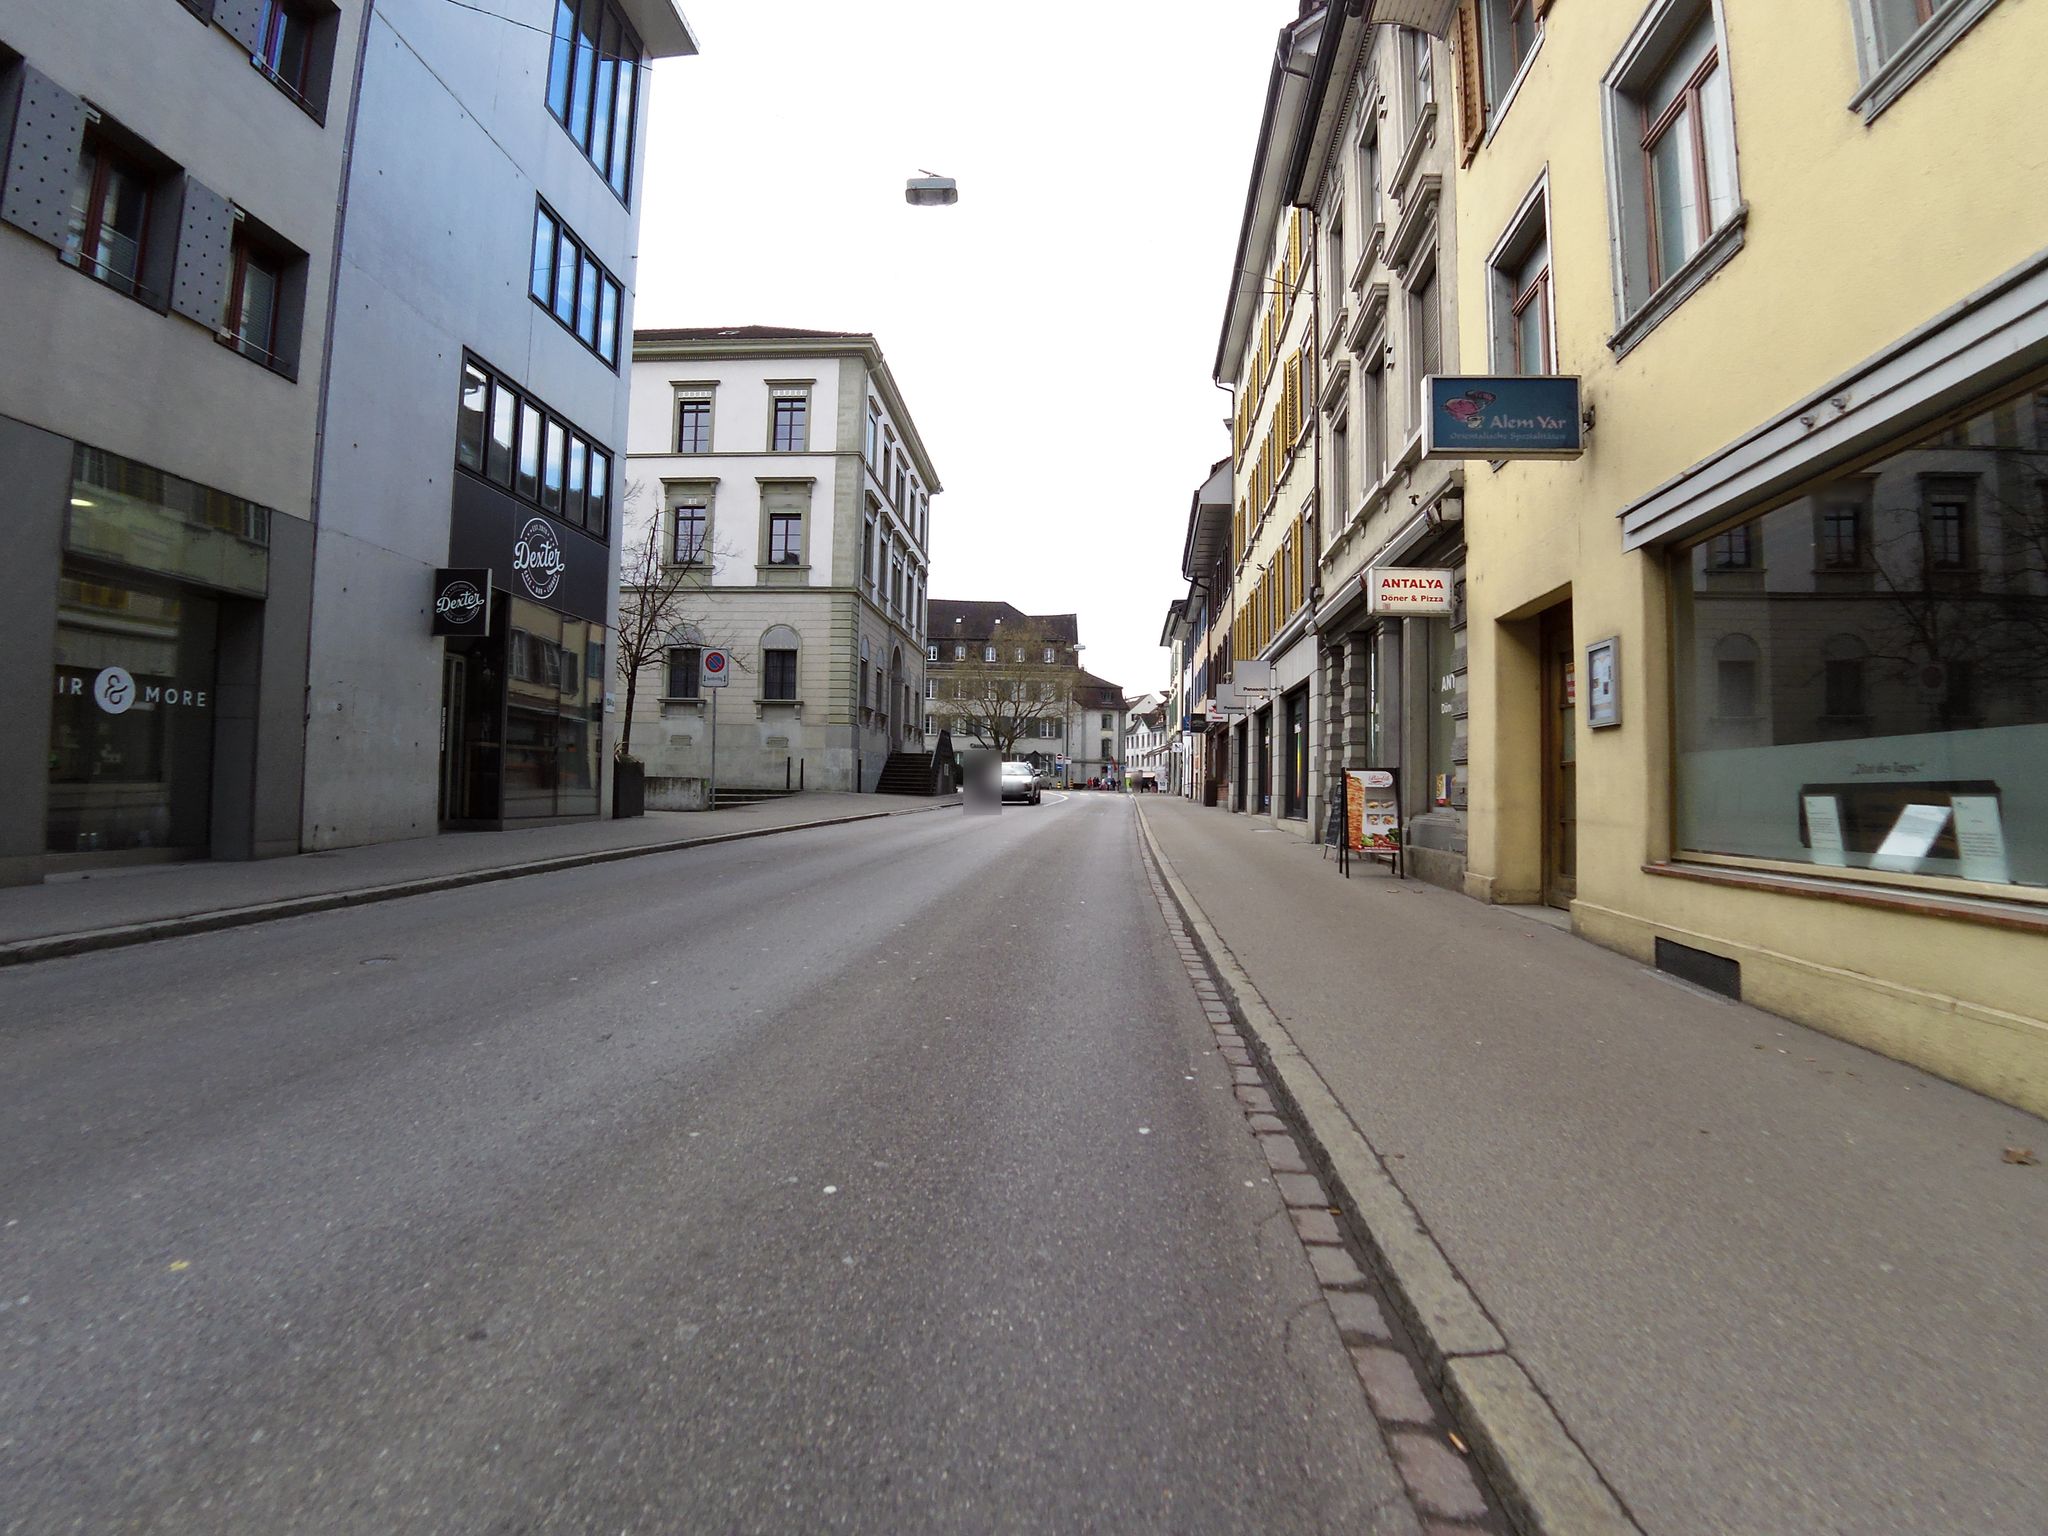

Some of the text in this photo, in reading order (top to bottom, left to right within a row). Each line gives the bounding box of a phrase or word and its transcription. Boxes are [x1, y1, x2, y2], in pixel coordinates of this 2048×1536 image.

[1489, 414, 1566, 429] Alem Yar
[514, 541, 565, 575] Dexter
[1382, 578, 1444, 589] ANTALYA
[435, 591, 485, 613] Dexter
[1381, 594, 1444, 602] Döner & Pizza
[145, 686, 206, 707] MORE
